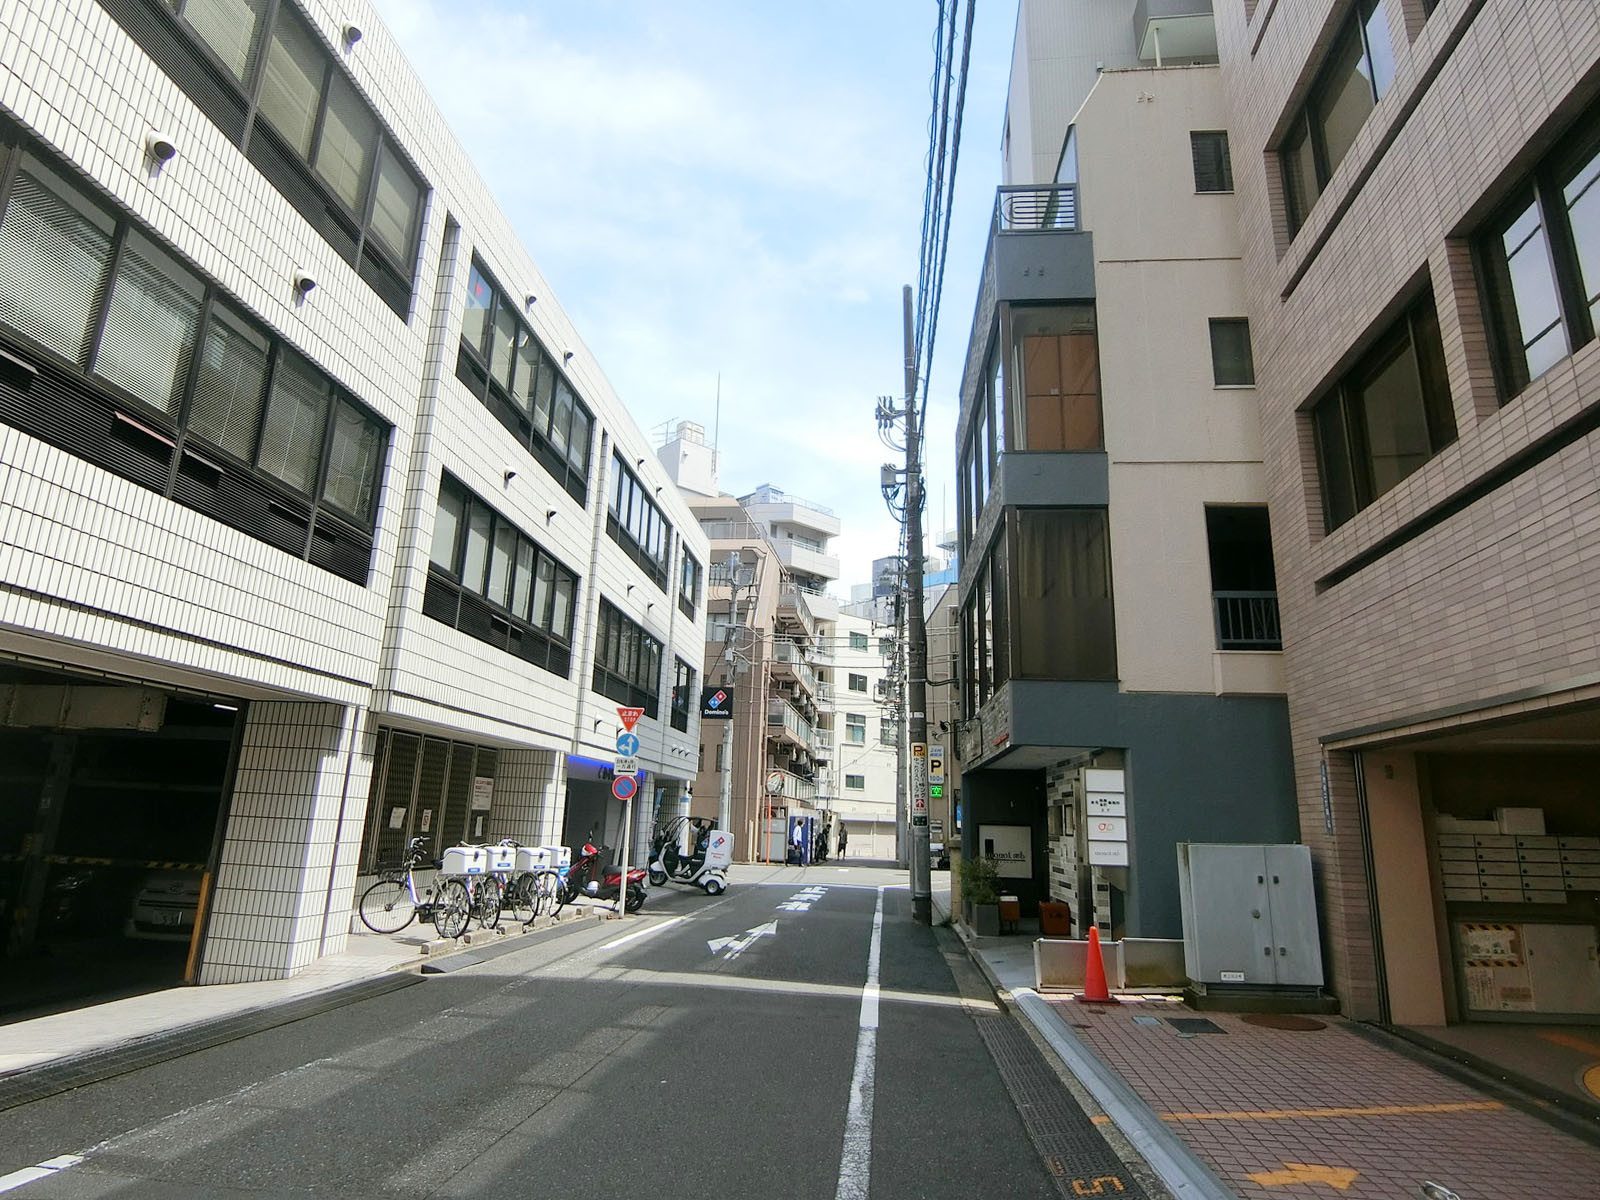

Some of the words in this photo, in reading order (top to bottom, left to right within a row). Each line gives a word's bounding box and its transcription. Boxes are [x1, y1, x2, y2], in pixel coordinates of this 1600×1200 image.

[913, 745, 923, 756] P
[930, 759, 942, 773] P
[775, 885, 829, 912] 止まれ
